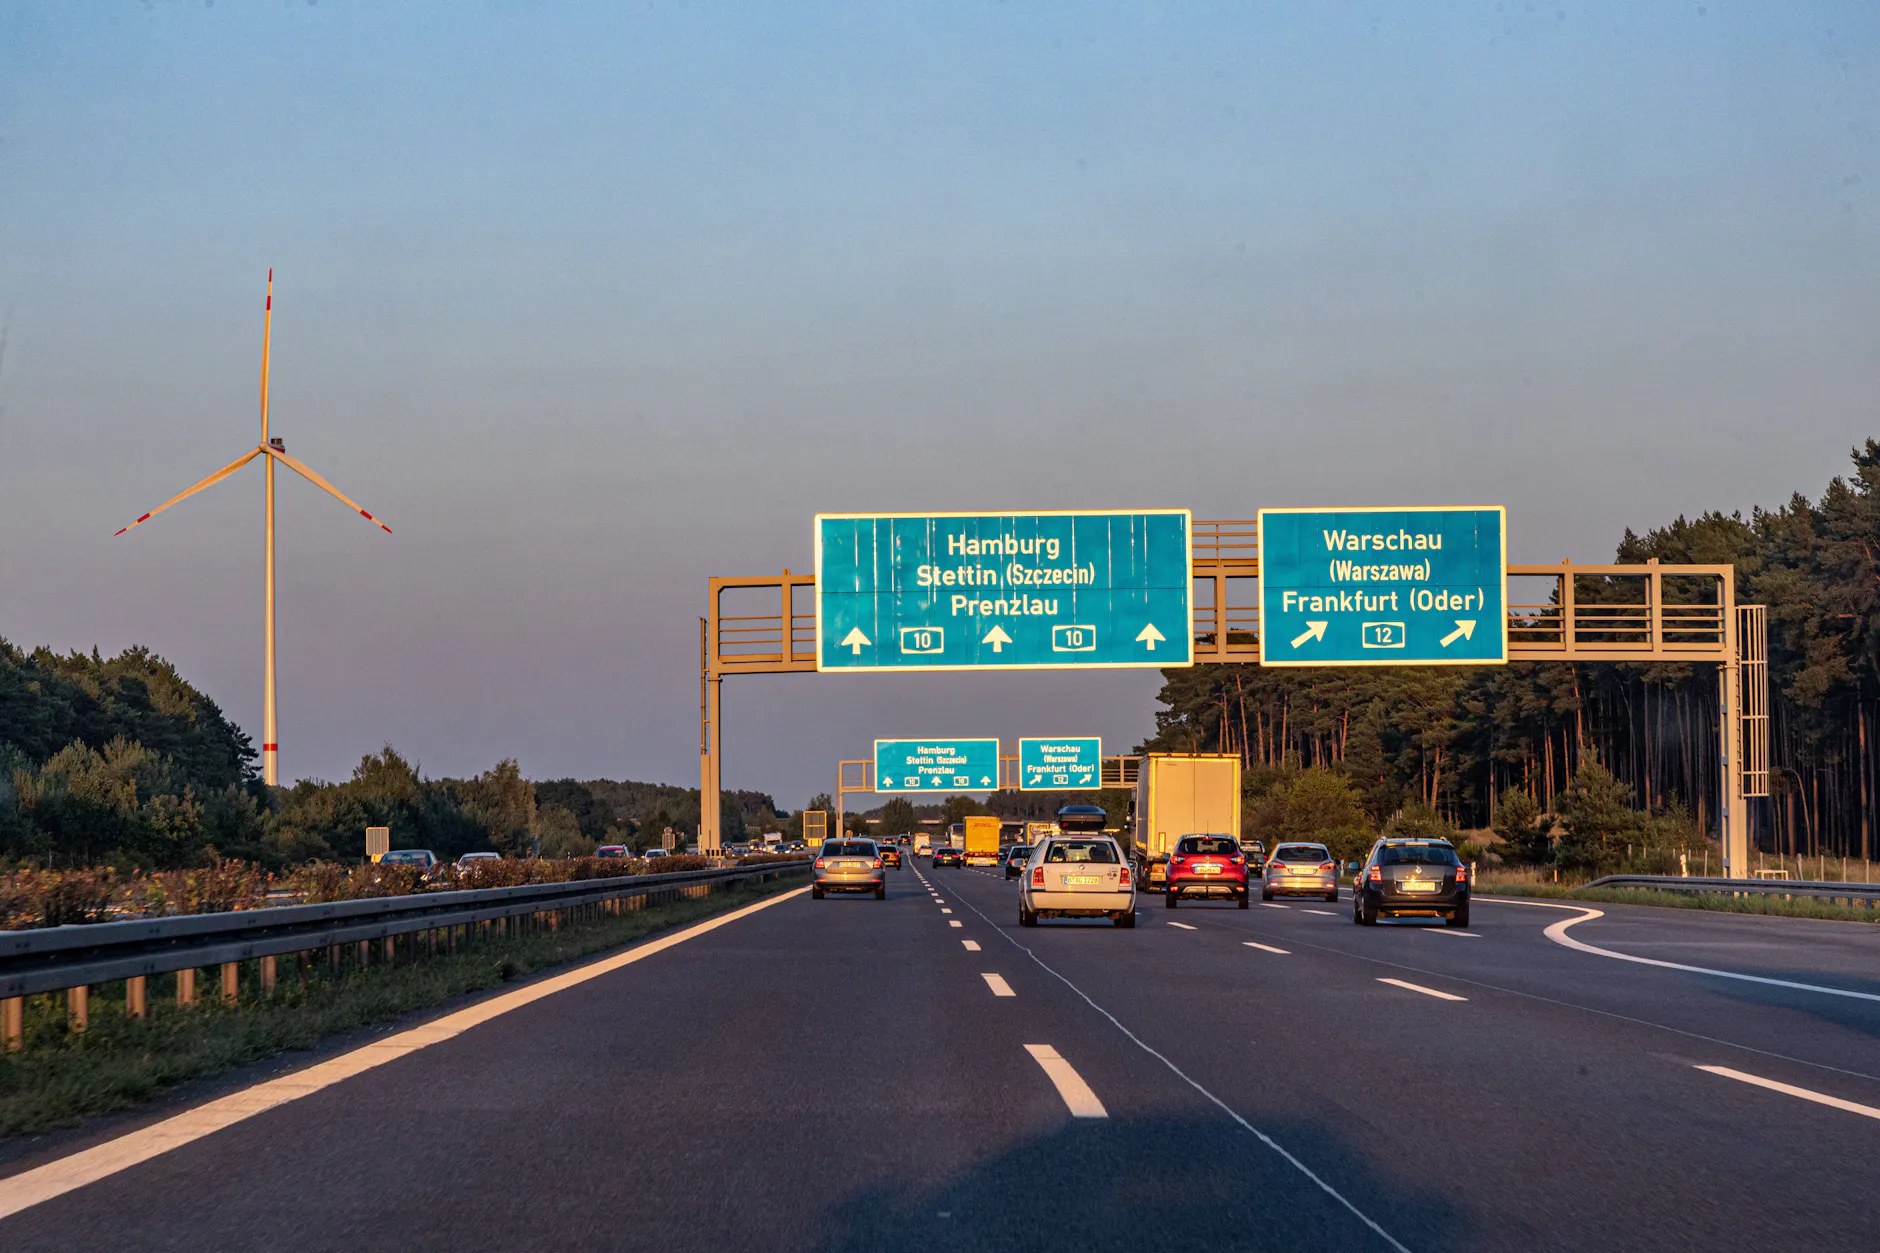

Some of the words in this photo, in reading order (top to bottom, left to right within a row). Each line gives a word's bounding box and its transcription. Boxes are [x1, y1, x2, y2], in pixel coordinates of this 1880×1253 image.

[948, 533, 1059, 560] Hamburg
[1323, 529, 1442, 551] Warschau
[917, 565, 996, 586] Stettin
[1007, 562, 1095, 586] (Szczecin)
[1330, 558, 1431, 582] (Warszawa)
[952, 595, 1058, 616] Prenzlau
[1283, 590, 1398, 612] Frankfurt
[1409, 588, 1484, 611] (Oder)
[914, 632, 931, 649] 10
[1066, 630, 1083, 647] 10
[1375, 627, 1392, 643] 12
[917, 746, 956, 755] Hamburg
[1040, 744, 1081, 753] Warschau
[906, 756, 934, 764] Stettin
[1027, 764, 1067, 773] Frankfurt
[1069, 763, 1095, 773] (Oder)
[918, 766, 955, 774] Prenzlau
